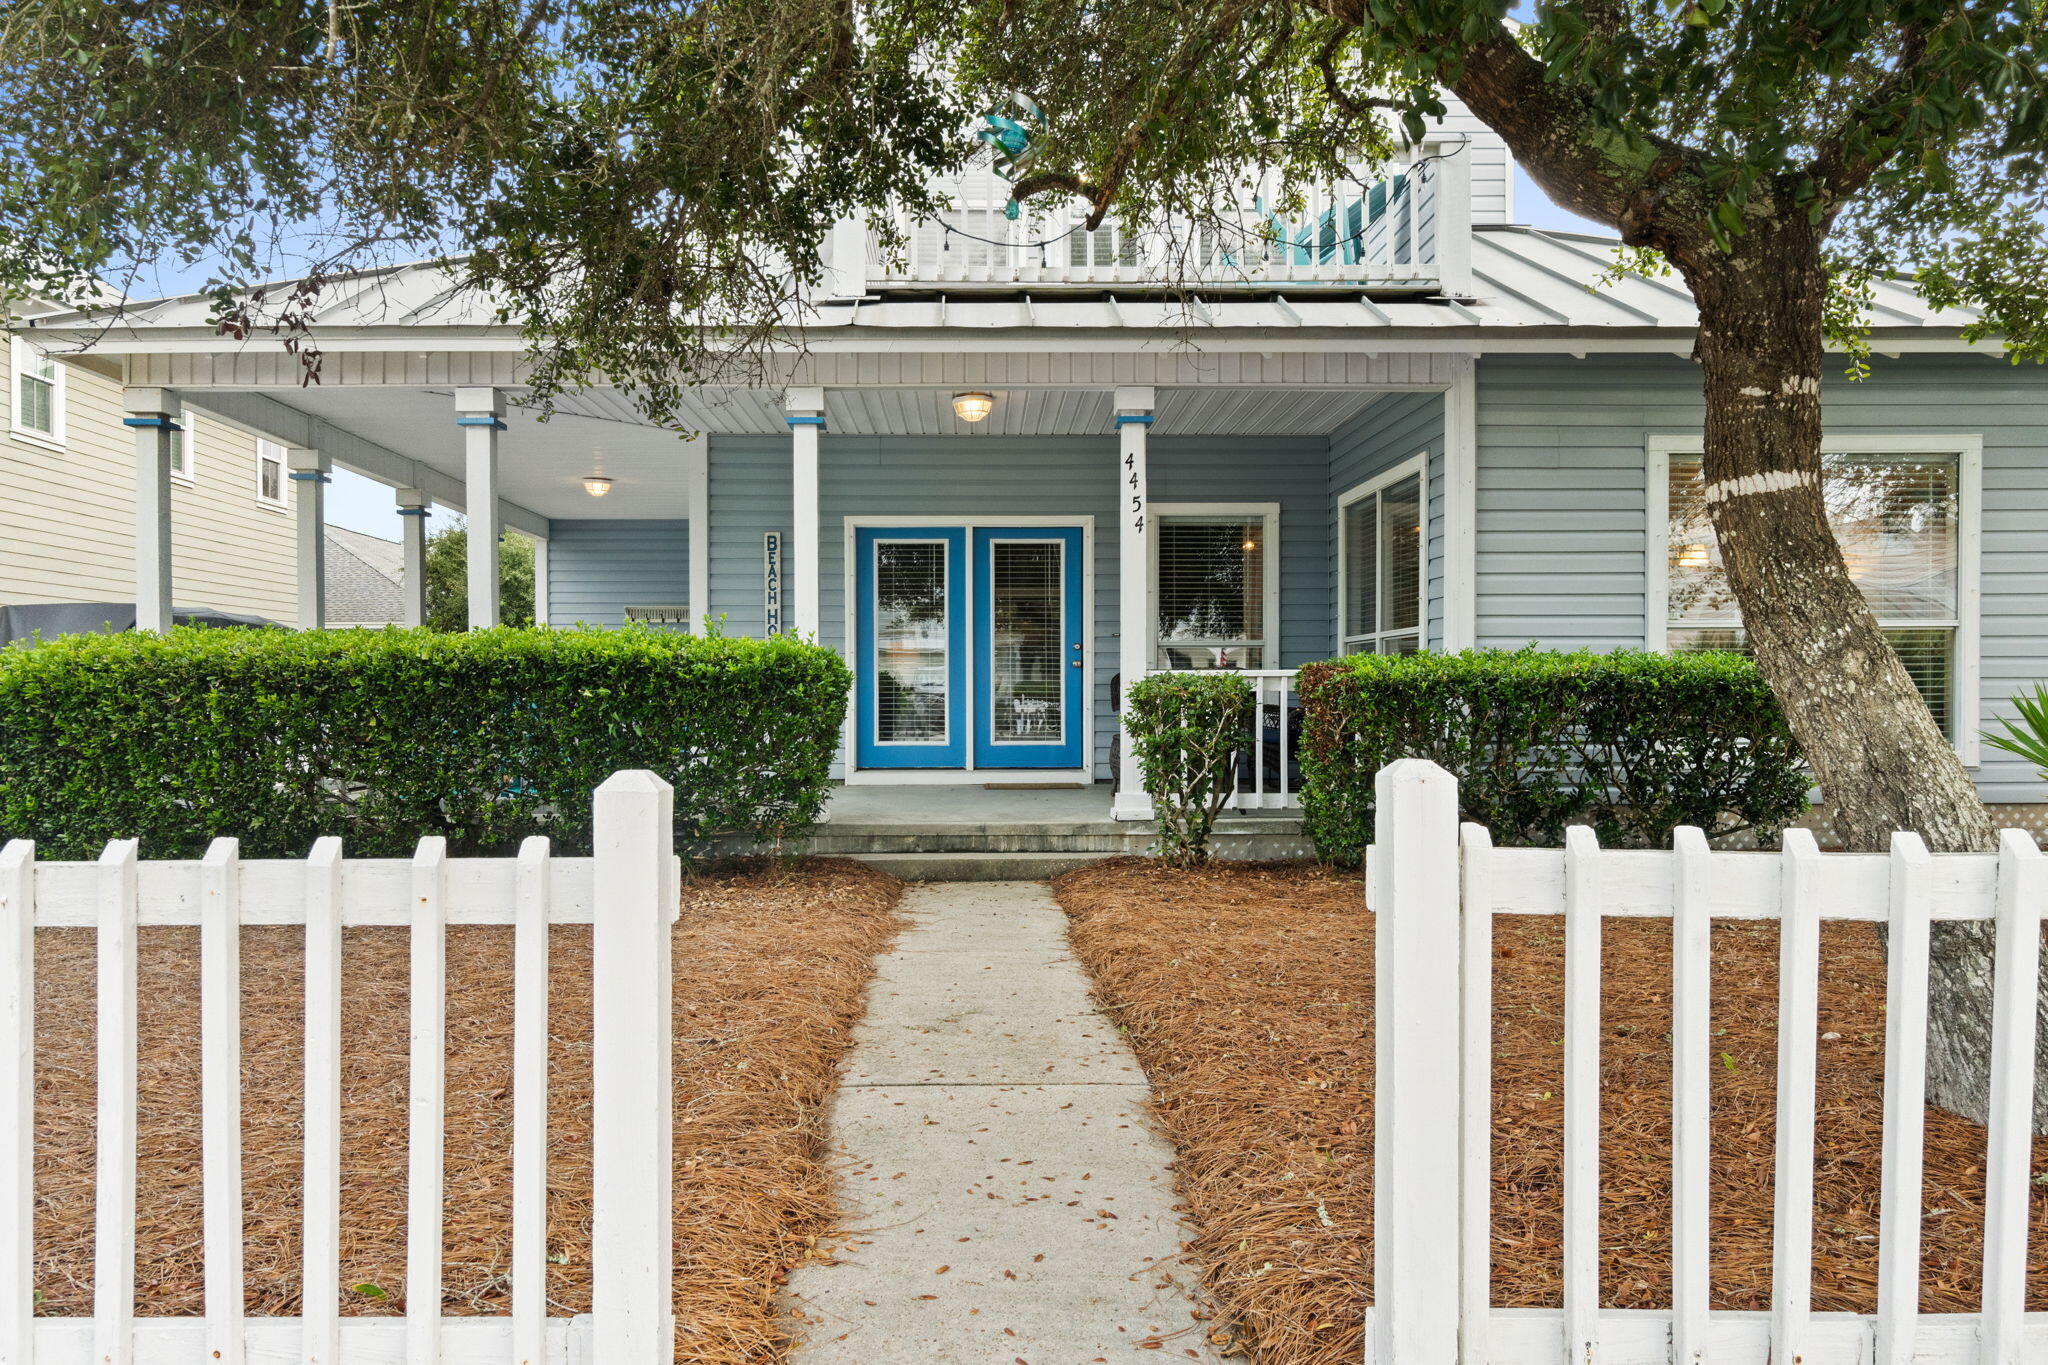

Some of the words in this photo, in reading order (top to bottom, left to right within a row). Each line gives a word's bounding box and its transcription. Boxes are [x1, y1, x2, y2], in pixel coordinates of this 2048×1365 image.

[1125, 452, 1144, 534] 4454
[766, 535, 778, 605] BEACH
[767, 608, 778, 640] HO
